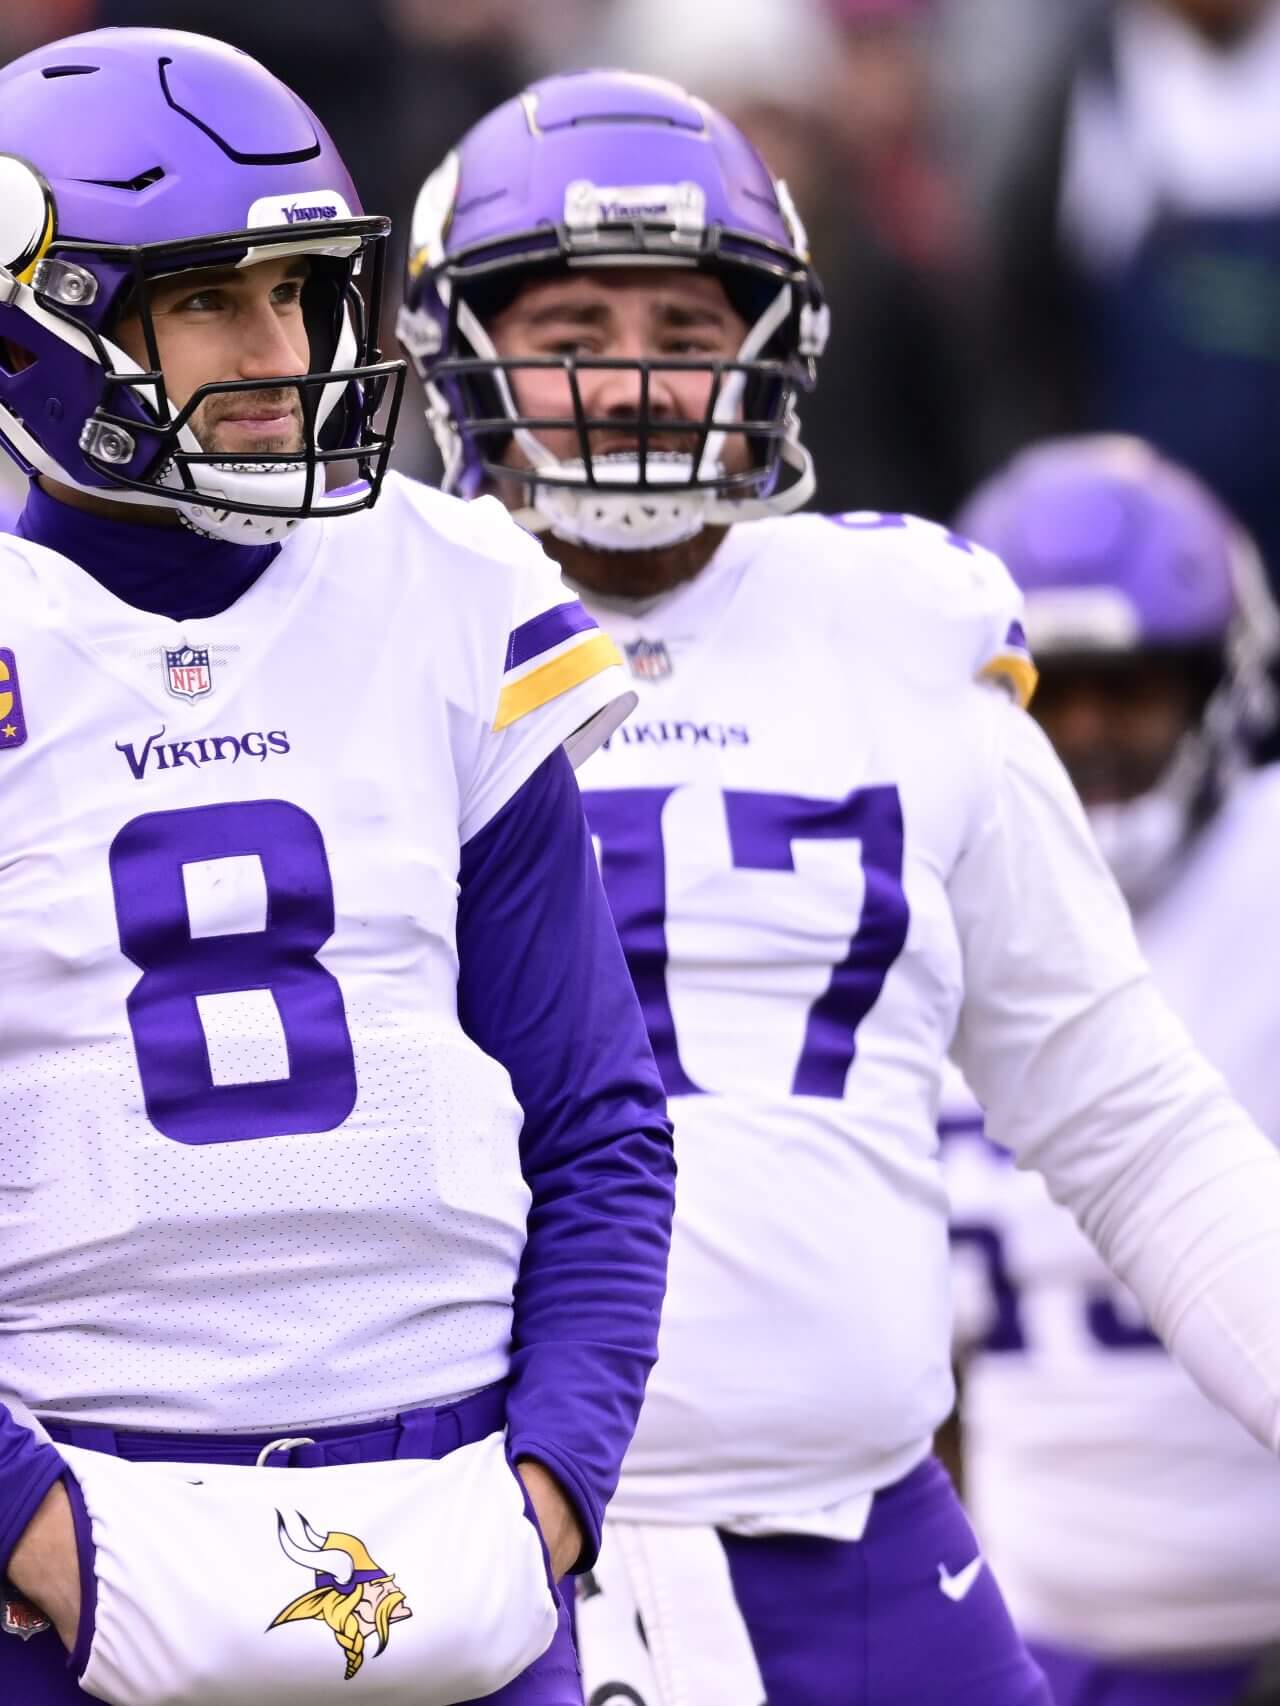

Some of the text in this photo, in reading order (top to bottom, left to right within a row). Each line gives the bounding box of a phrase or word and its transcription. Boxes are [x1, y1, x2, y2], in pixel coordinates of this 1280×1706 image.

[171, 667, 209, 693] NFL
[115, 724, 291, 780] VIKINGS
[602, 719, 751, 750] IKINGS
[109, 799, 358, 1146] 8
